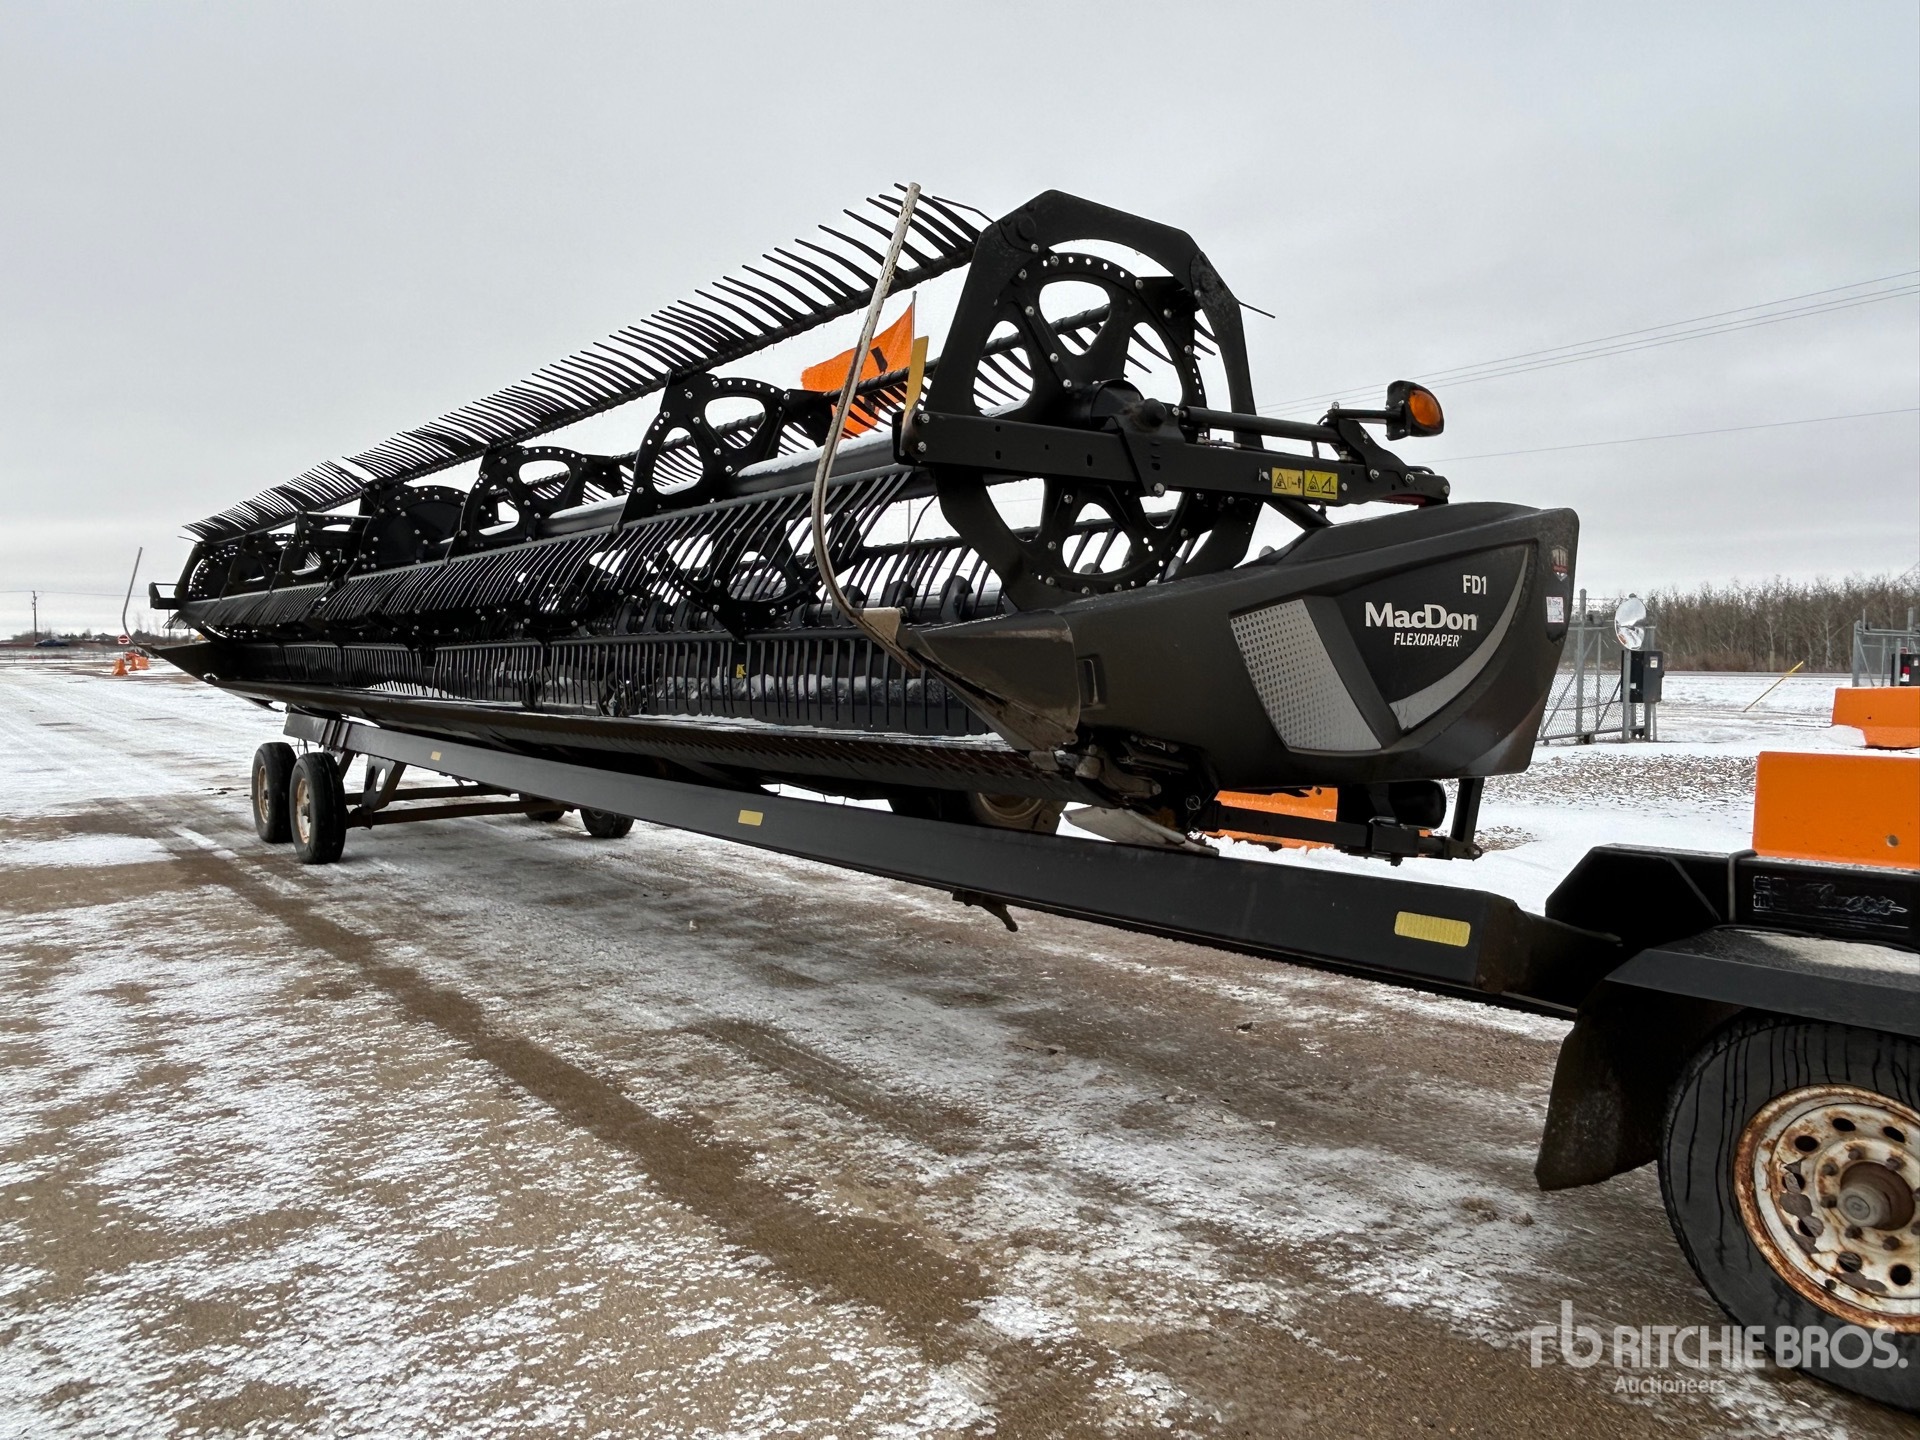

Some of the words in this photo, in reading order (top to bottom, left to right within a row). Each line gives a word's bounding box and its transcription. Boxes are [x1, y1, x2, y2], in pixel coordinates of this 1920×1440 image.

[1462, 574, 1487, 595] FD1
[1365, 601, 1477, 631] MacDon
[1393, 632, 1461, 647] FLEXDRAPER
